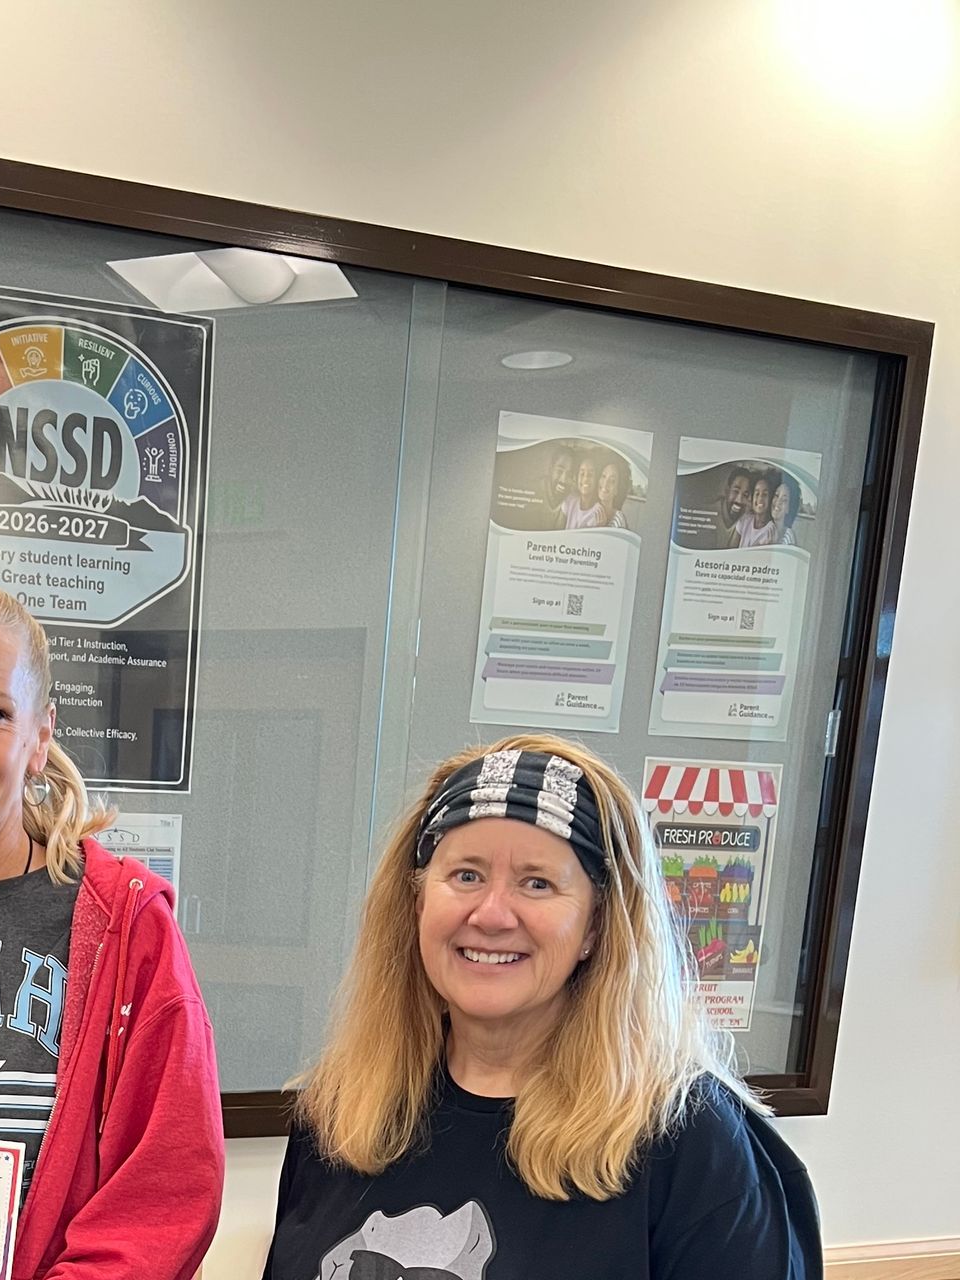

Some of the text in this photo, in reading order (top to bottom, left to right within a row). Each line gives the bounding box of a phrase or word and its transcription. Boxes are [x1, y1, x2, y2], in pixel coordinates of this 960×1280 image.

[11, 333, 48, 346] INITIATIVE
[78, 338, 115, 360] RESILIENT
[137, 373, 161, 405] CURIOUS
[166, 432, 177, 478] CONFIDENT
[526, 541, 602, 561] Parent Coaching
[19, 549, 73, 567] student
[76, 553, 131, 575] learning
[695, 559, 780, 575] Asesoría para padres
[1, 569, 105, 594] Great teaching
[16, 592, 87, 611] One Team
[532, 597, 546, 606] Sign
[58, 637, 75, 647] Tier
[76, 638, 82, 647] 1
[83, 639, 128, 652] Instruction,
[71, 654, 86, 662] and
[88, 654, 126, 665] Academic
[127, 656, 167, 668] Assurance
[59, 696, 103, 707] Instruction
[567, 693, 589, 701] Parent
[65, 727, 105, 738] Collective
[663, 828, 697, 844] FRESH
[705, 996, 744, 1004] PROGRAM
